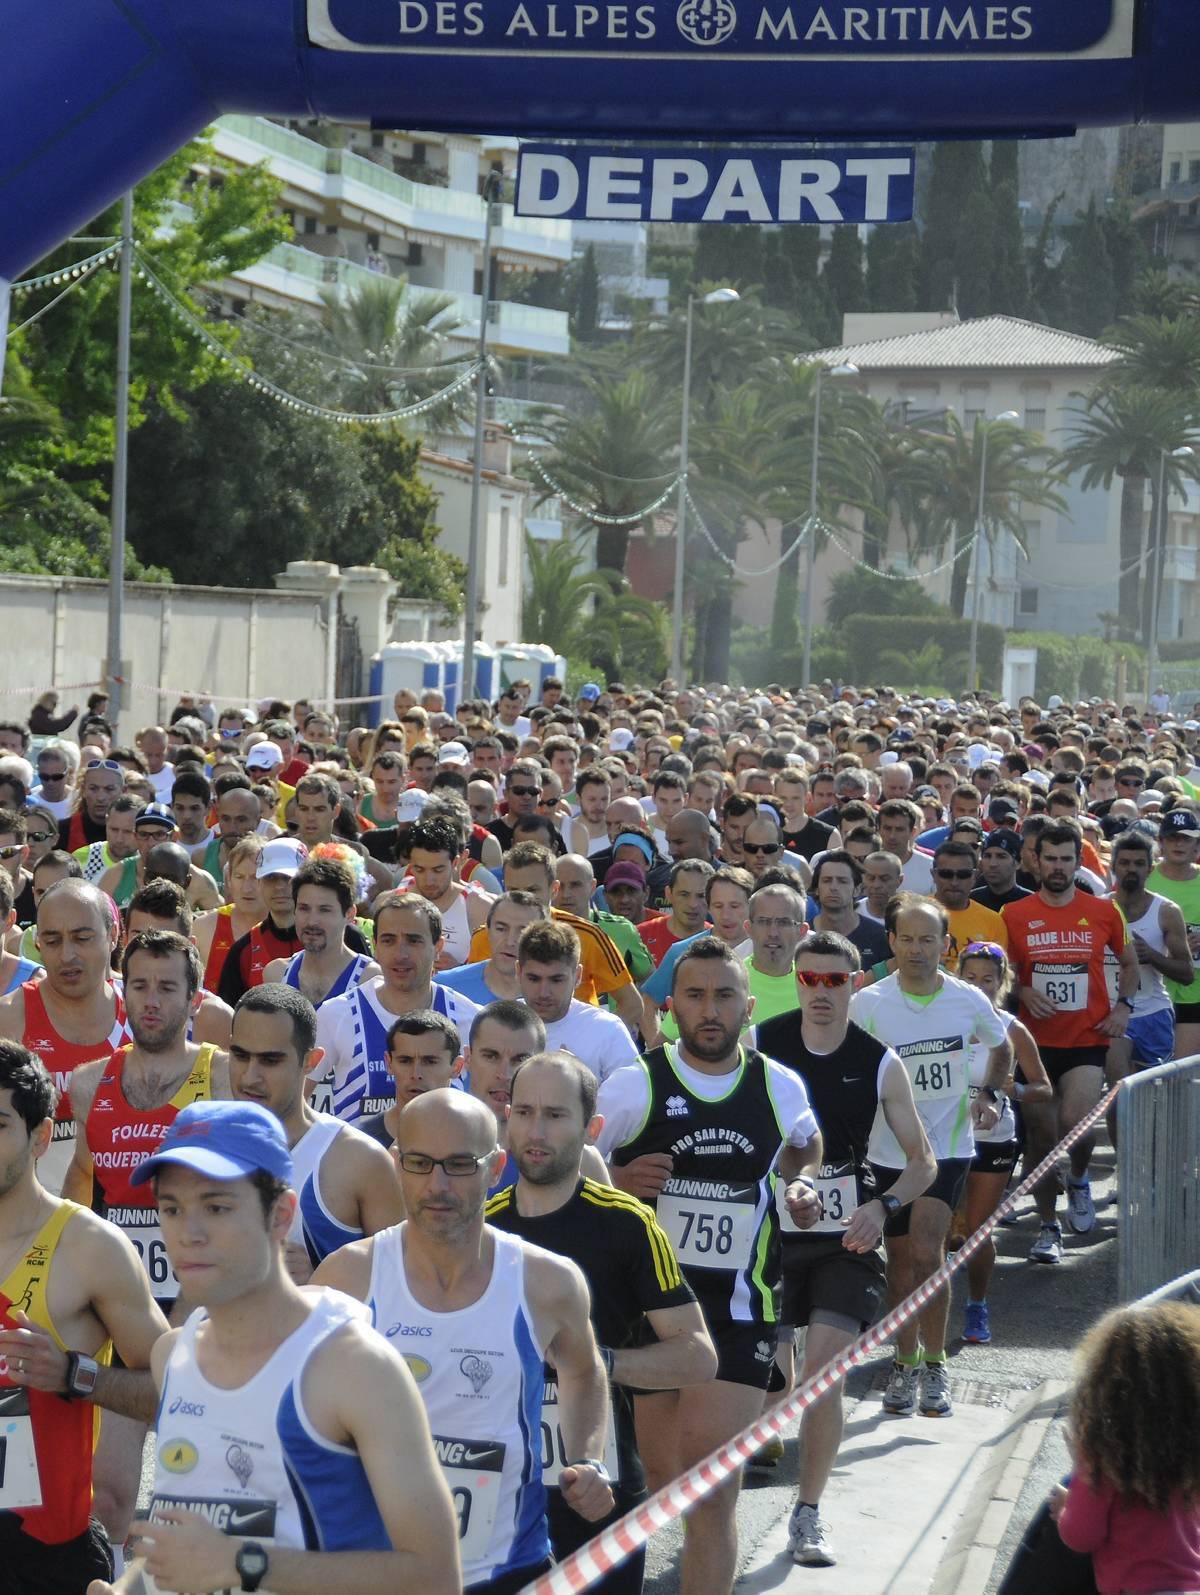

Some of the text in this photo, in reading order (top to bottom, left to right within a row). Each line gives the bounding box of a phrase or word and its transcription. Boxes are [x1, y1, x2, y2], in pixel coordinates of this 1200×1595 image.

[399, 1, 1033, 40] DES ALPES MARITIMES
[517, 152, 911, 221] DEPART
[1027, 931, 1093, 946] BLUE LINE
[1034, 963, 1072, 973] RUNNING
[1046, 981, 1076, 1003] 631
[899, 1041, 943, 1056] RUNNING
[369, 1061, 386, 1072] STA
[915, 1061, 951, 1091] 481
[670, 1128, 755, 1154] PRO SAN PIETRO
[694, 1144, 733, 1155] SANREMO
[665, 1179, 729, 1199] RUNNING
[107, 1208, 160, 1225] RUNNIN
[678, 1211, 733, 1254] 758
